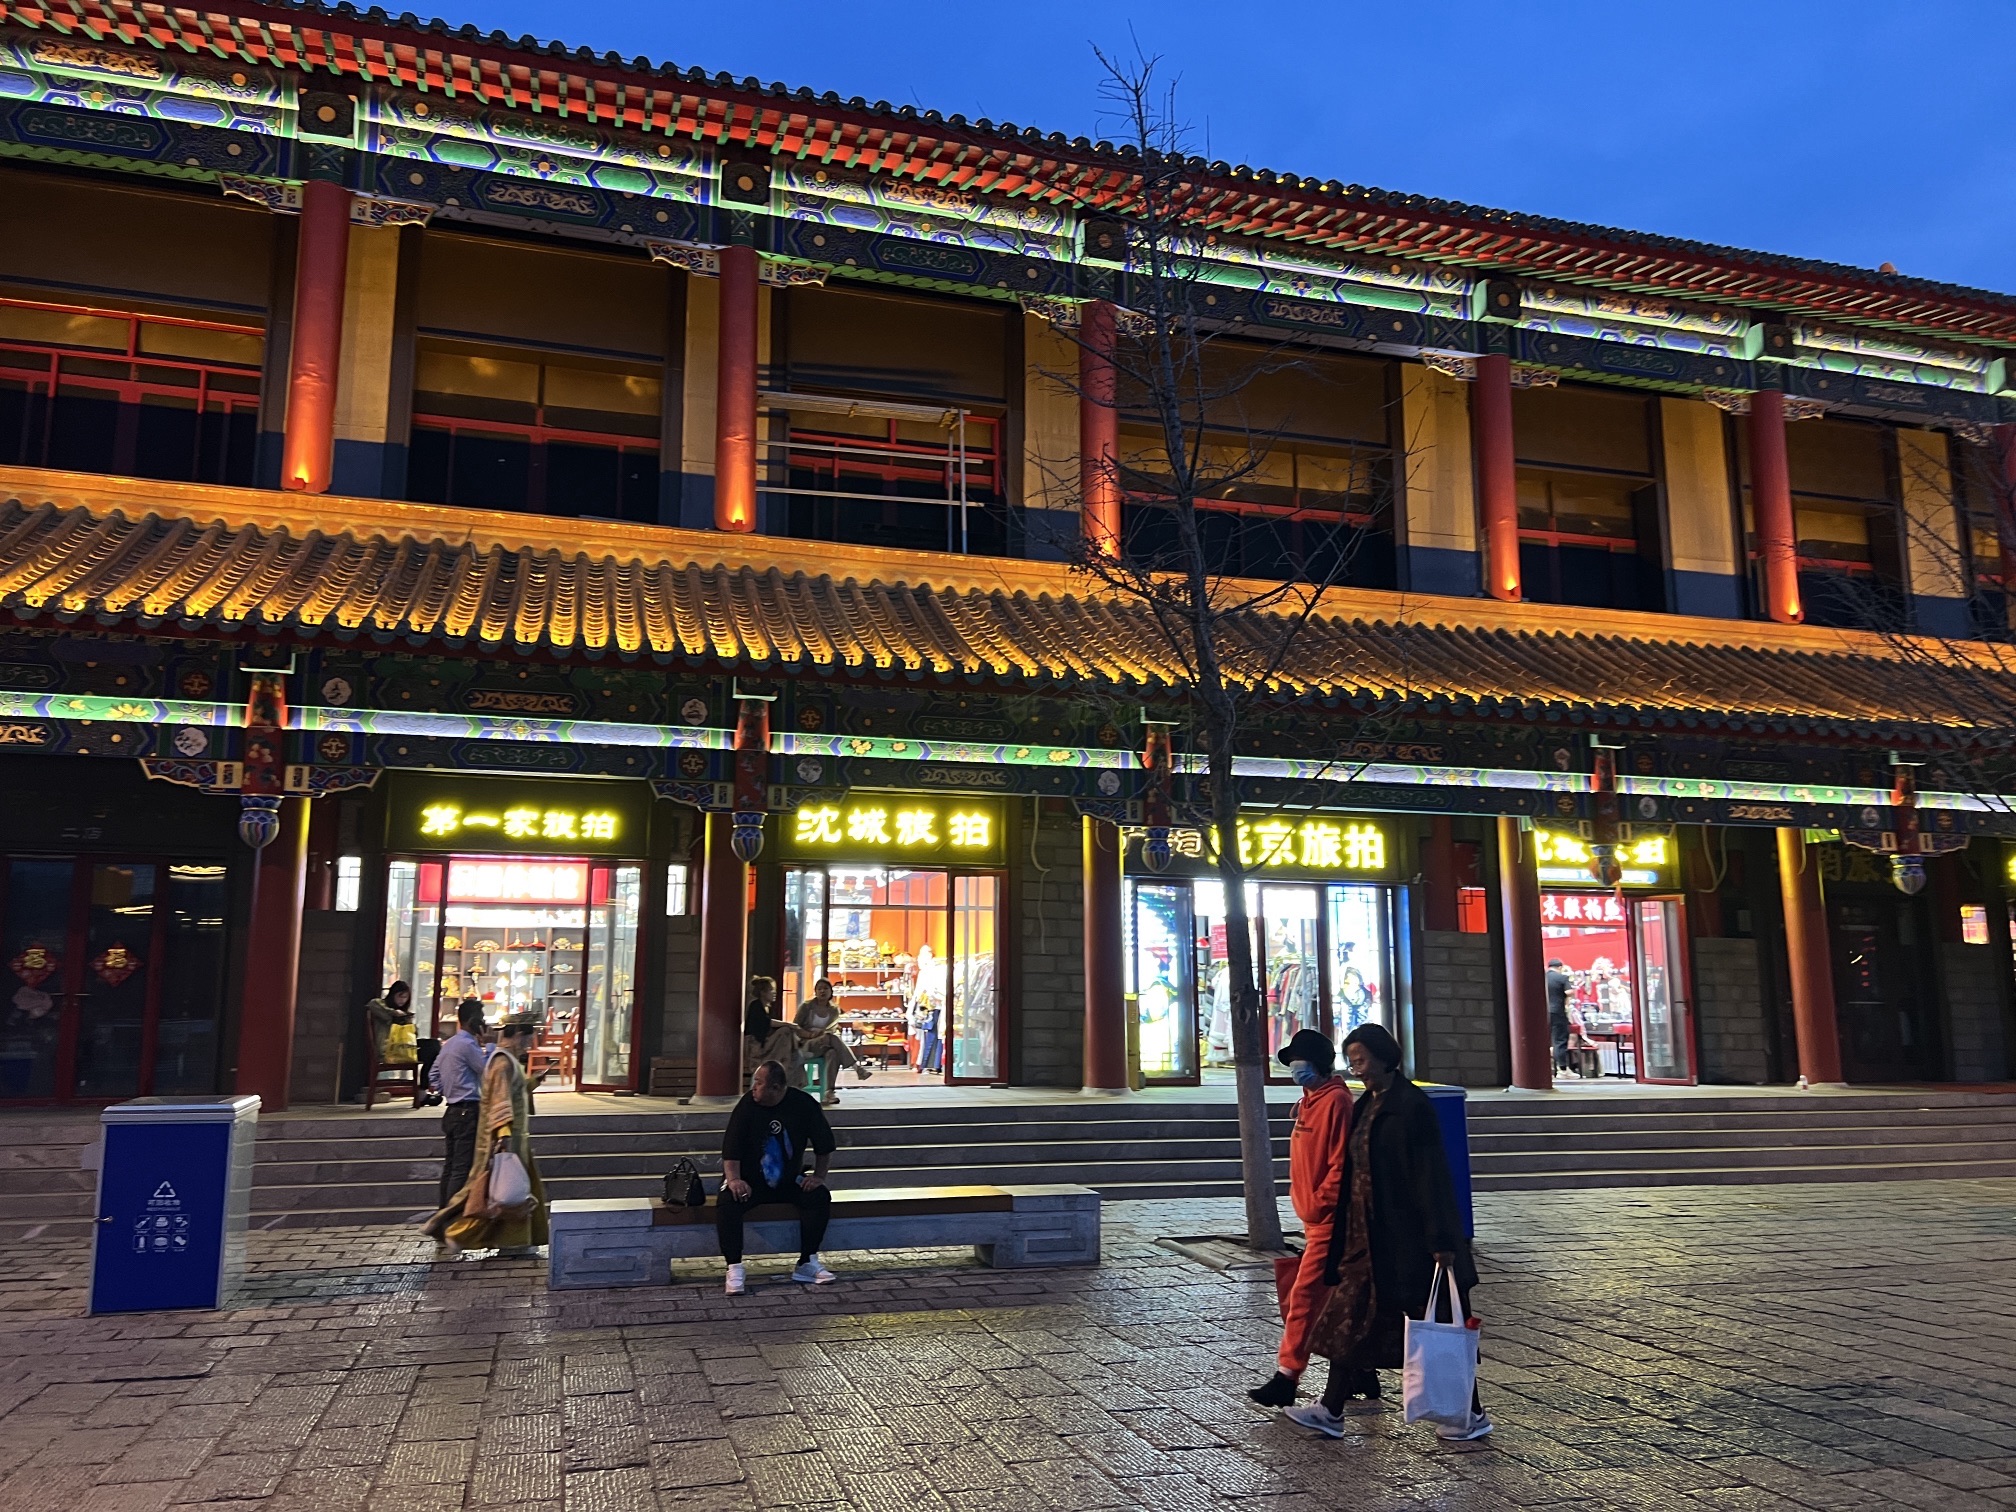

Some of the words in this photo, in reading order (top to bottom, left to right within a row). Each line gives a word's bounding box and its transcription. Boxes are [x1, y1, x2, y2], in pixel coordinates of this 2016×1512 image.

[421, 804, 619, 840] 第一家旅拍
[795, 806, 992, 847] 沈城旅拍
